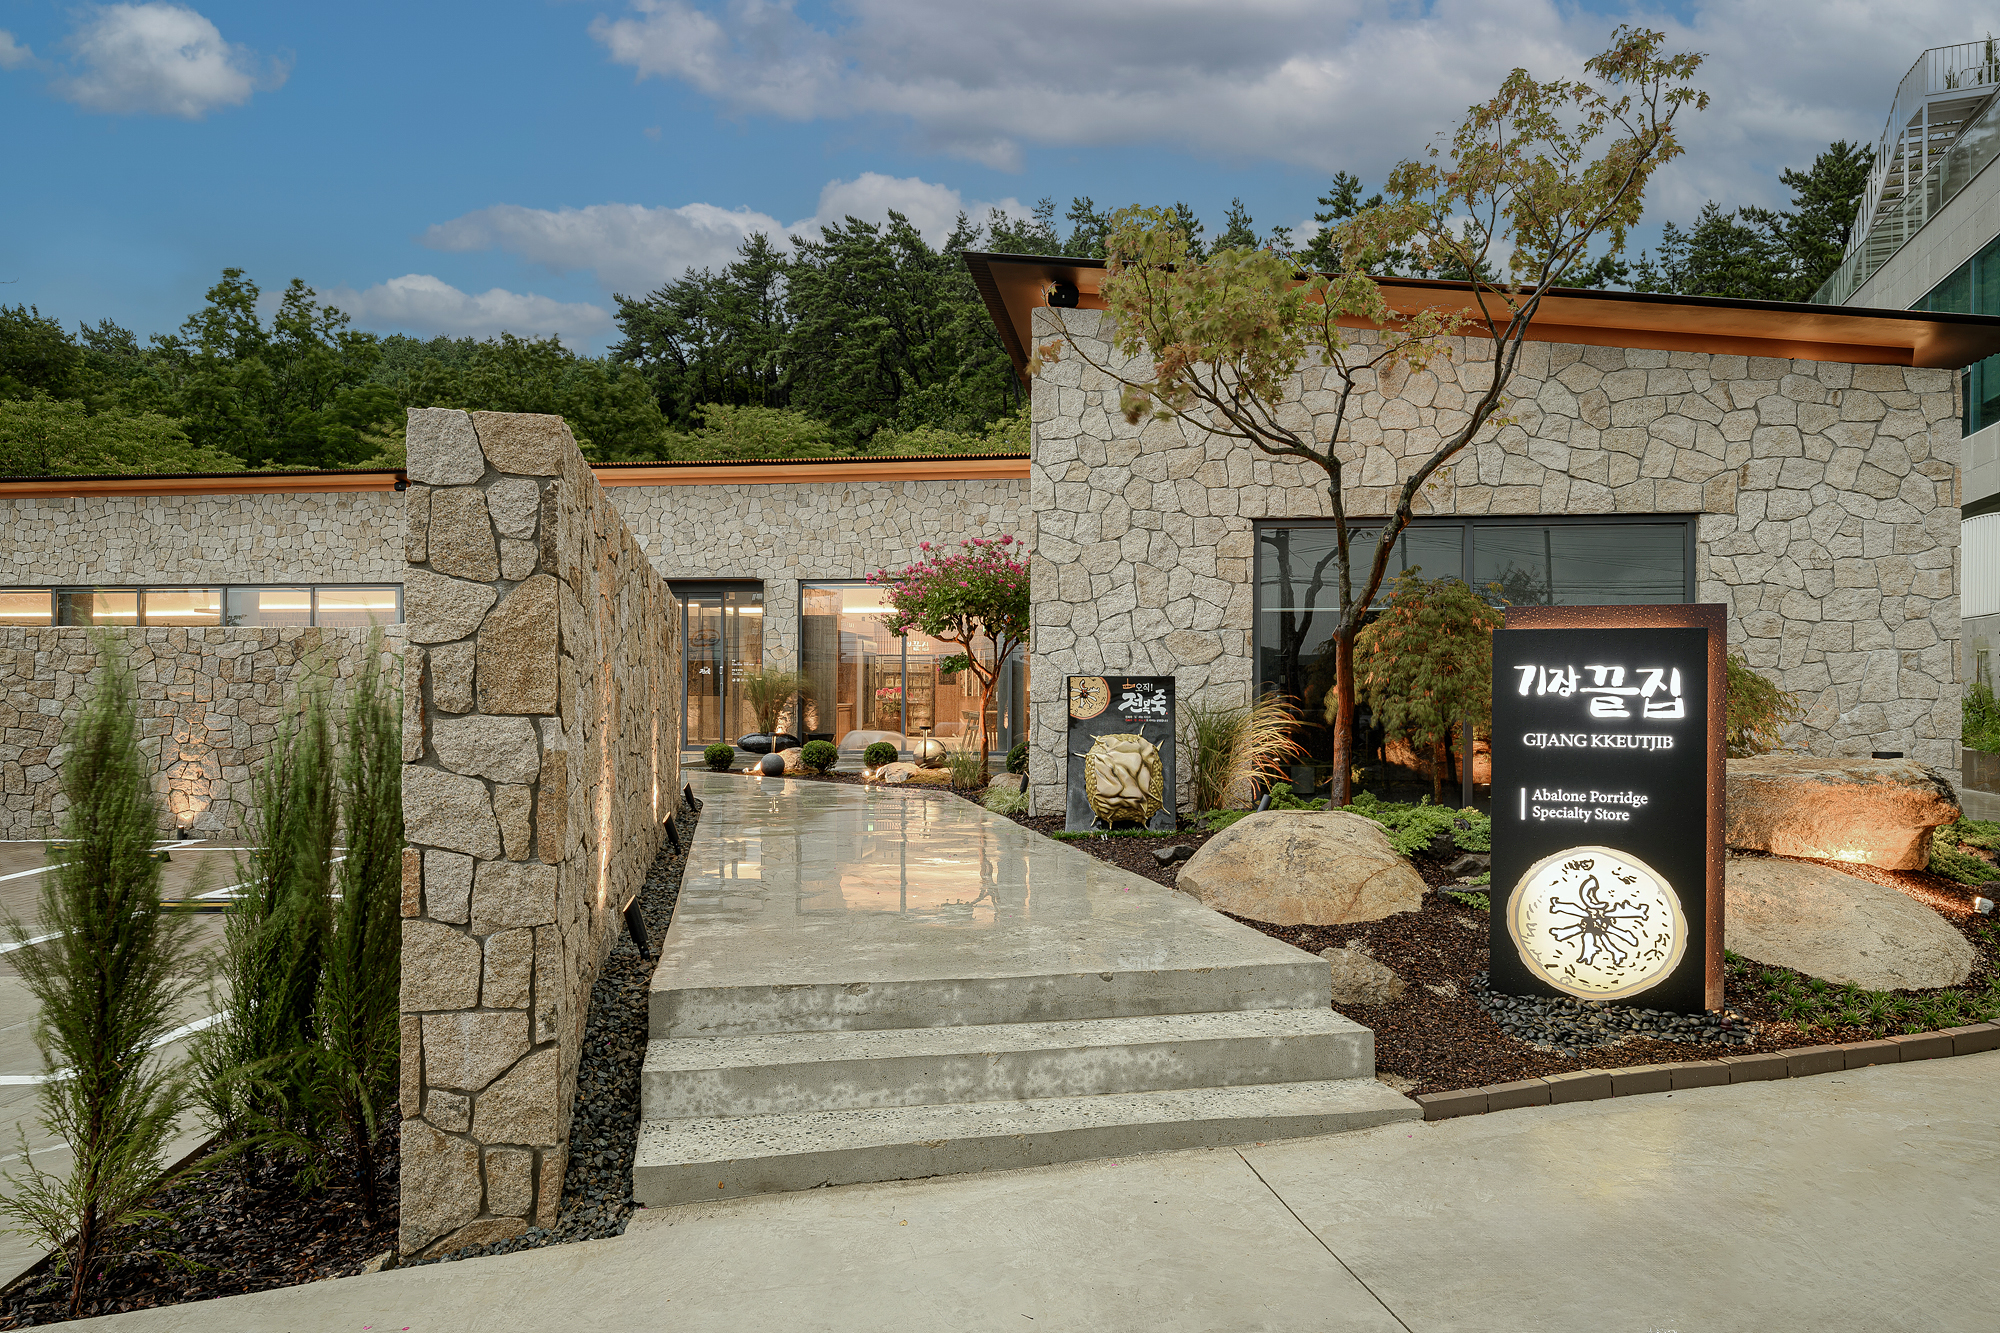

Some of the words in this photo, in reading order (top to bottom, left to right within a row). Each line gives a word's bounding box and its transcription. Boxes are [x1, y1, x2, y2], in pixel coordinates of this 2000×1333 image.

[1135, 682, 1154, 692] 오직!
[1523, 733, 1588, 749] GIJANG
[1590, 734, 1674, 751] KKEUTJIB
[1531, 788, 1587, 802] Abalone
[1590, 790, 1649, 808] Porridge
[1532, 805, 1592, 823] Specialty
[1594, 808, 1630, 821] Store
